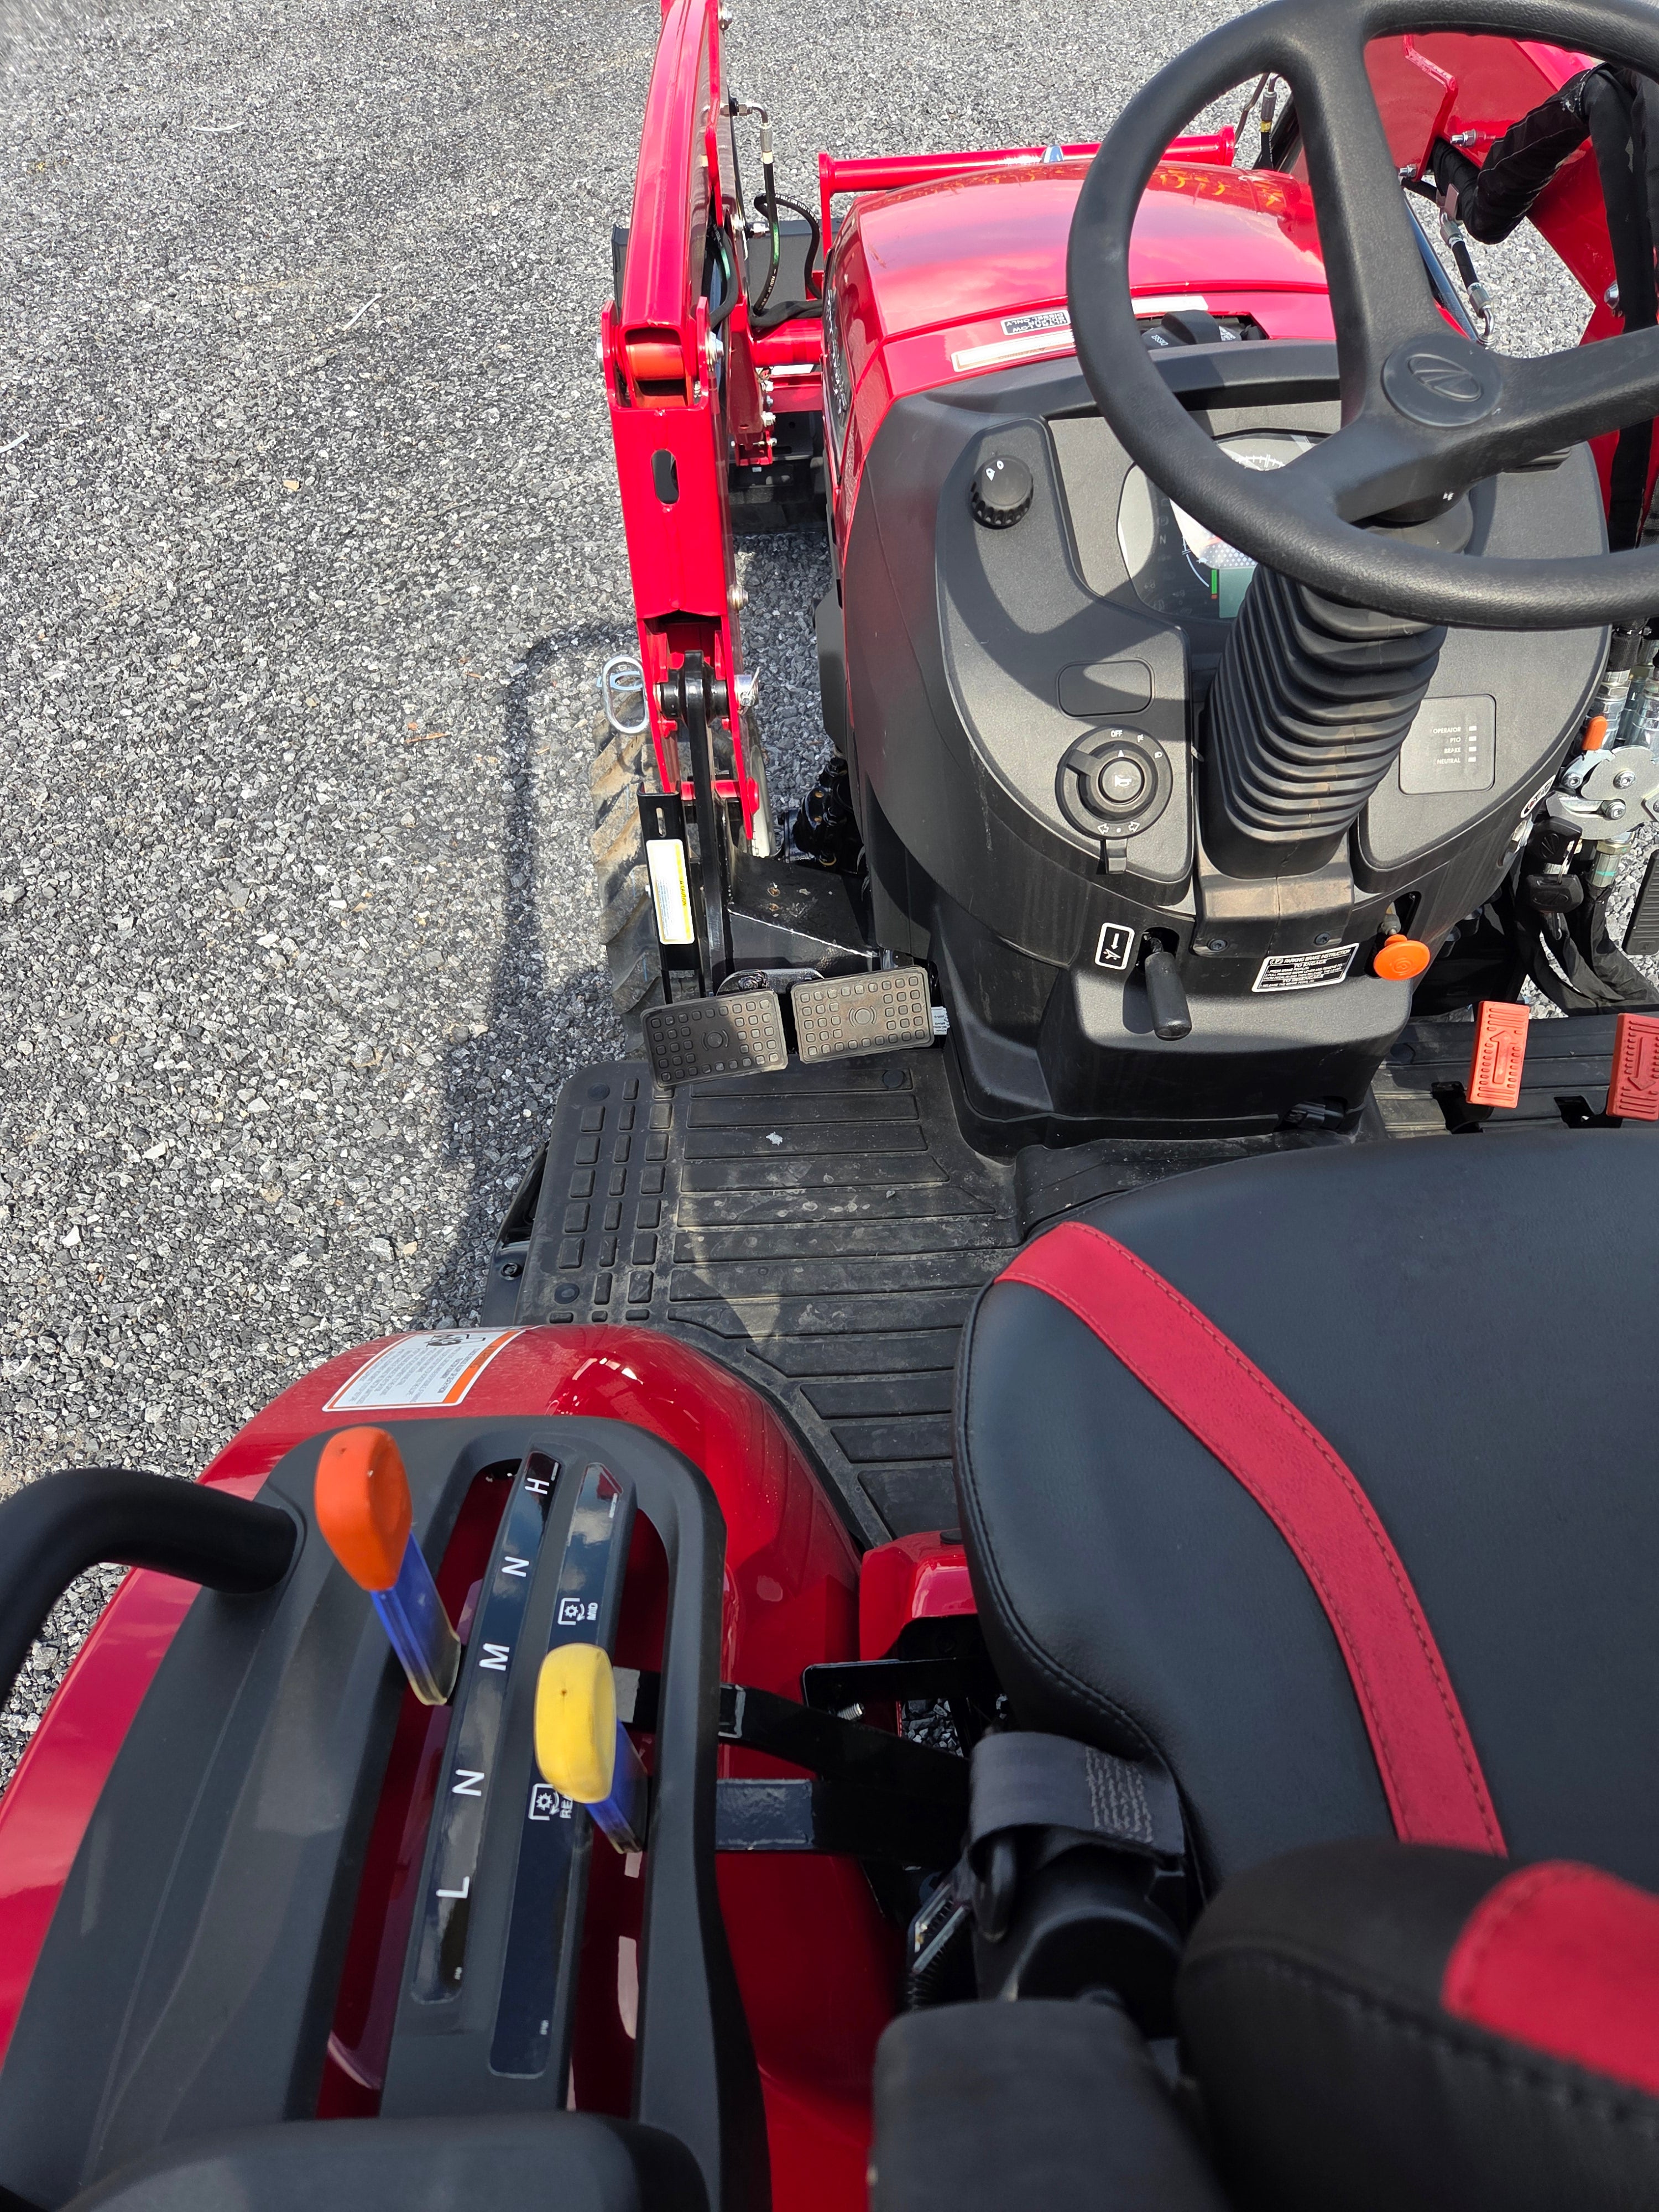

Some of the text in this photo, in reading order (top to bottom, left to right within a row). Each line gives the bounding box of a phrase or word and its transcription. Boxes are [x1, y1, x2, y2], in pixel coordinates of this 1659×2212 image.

[1006, 318, 1031, 326] ONLY
[1013, 324, 1034, 332] LOW
[1321, 948, 1351, 959] INSTRUCTION
[1302, 959, 1327, 967] ENGAGE
[525, 1478, 550, 1495] H
[502, 1556, 529, 1577] N
[587, 1602, 598, 1621] MID
[479, 1642, 510, 1671] M
[452, 1769, 485, 1797] N
[436, 1876, 470, 1898] L
